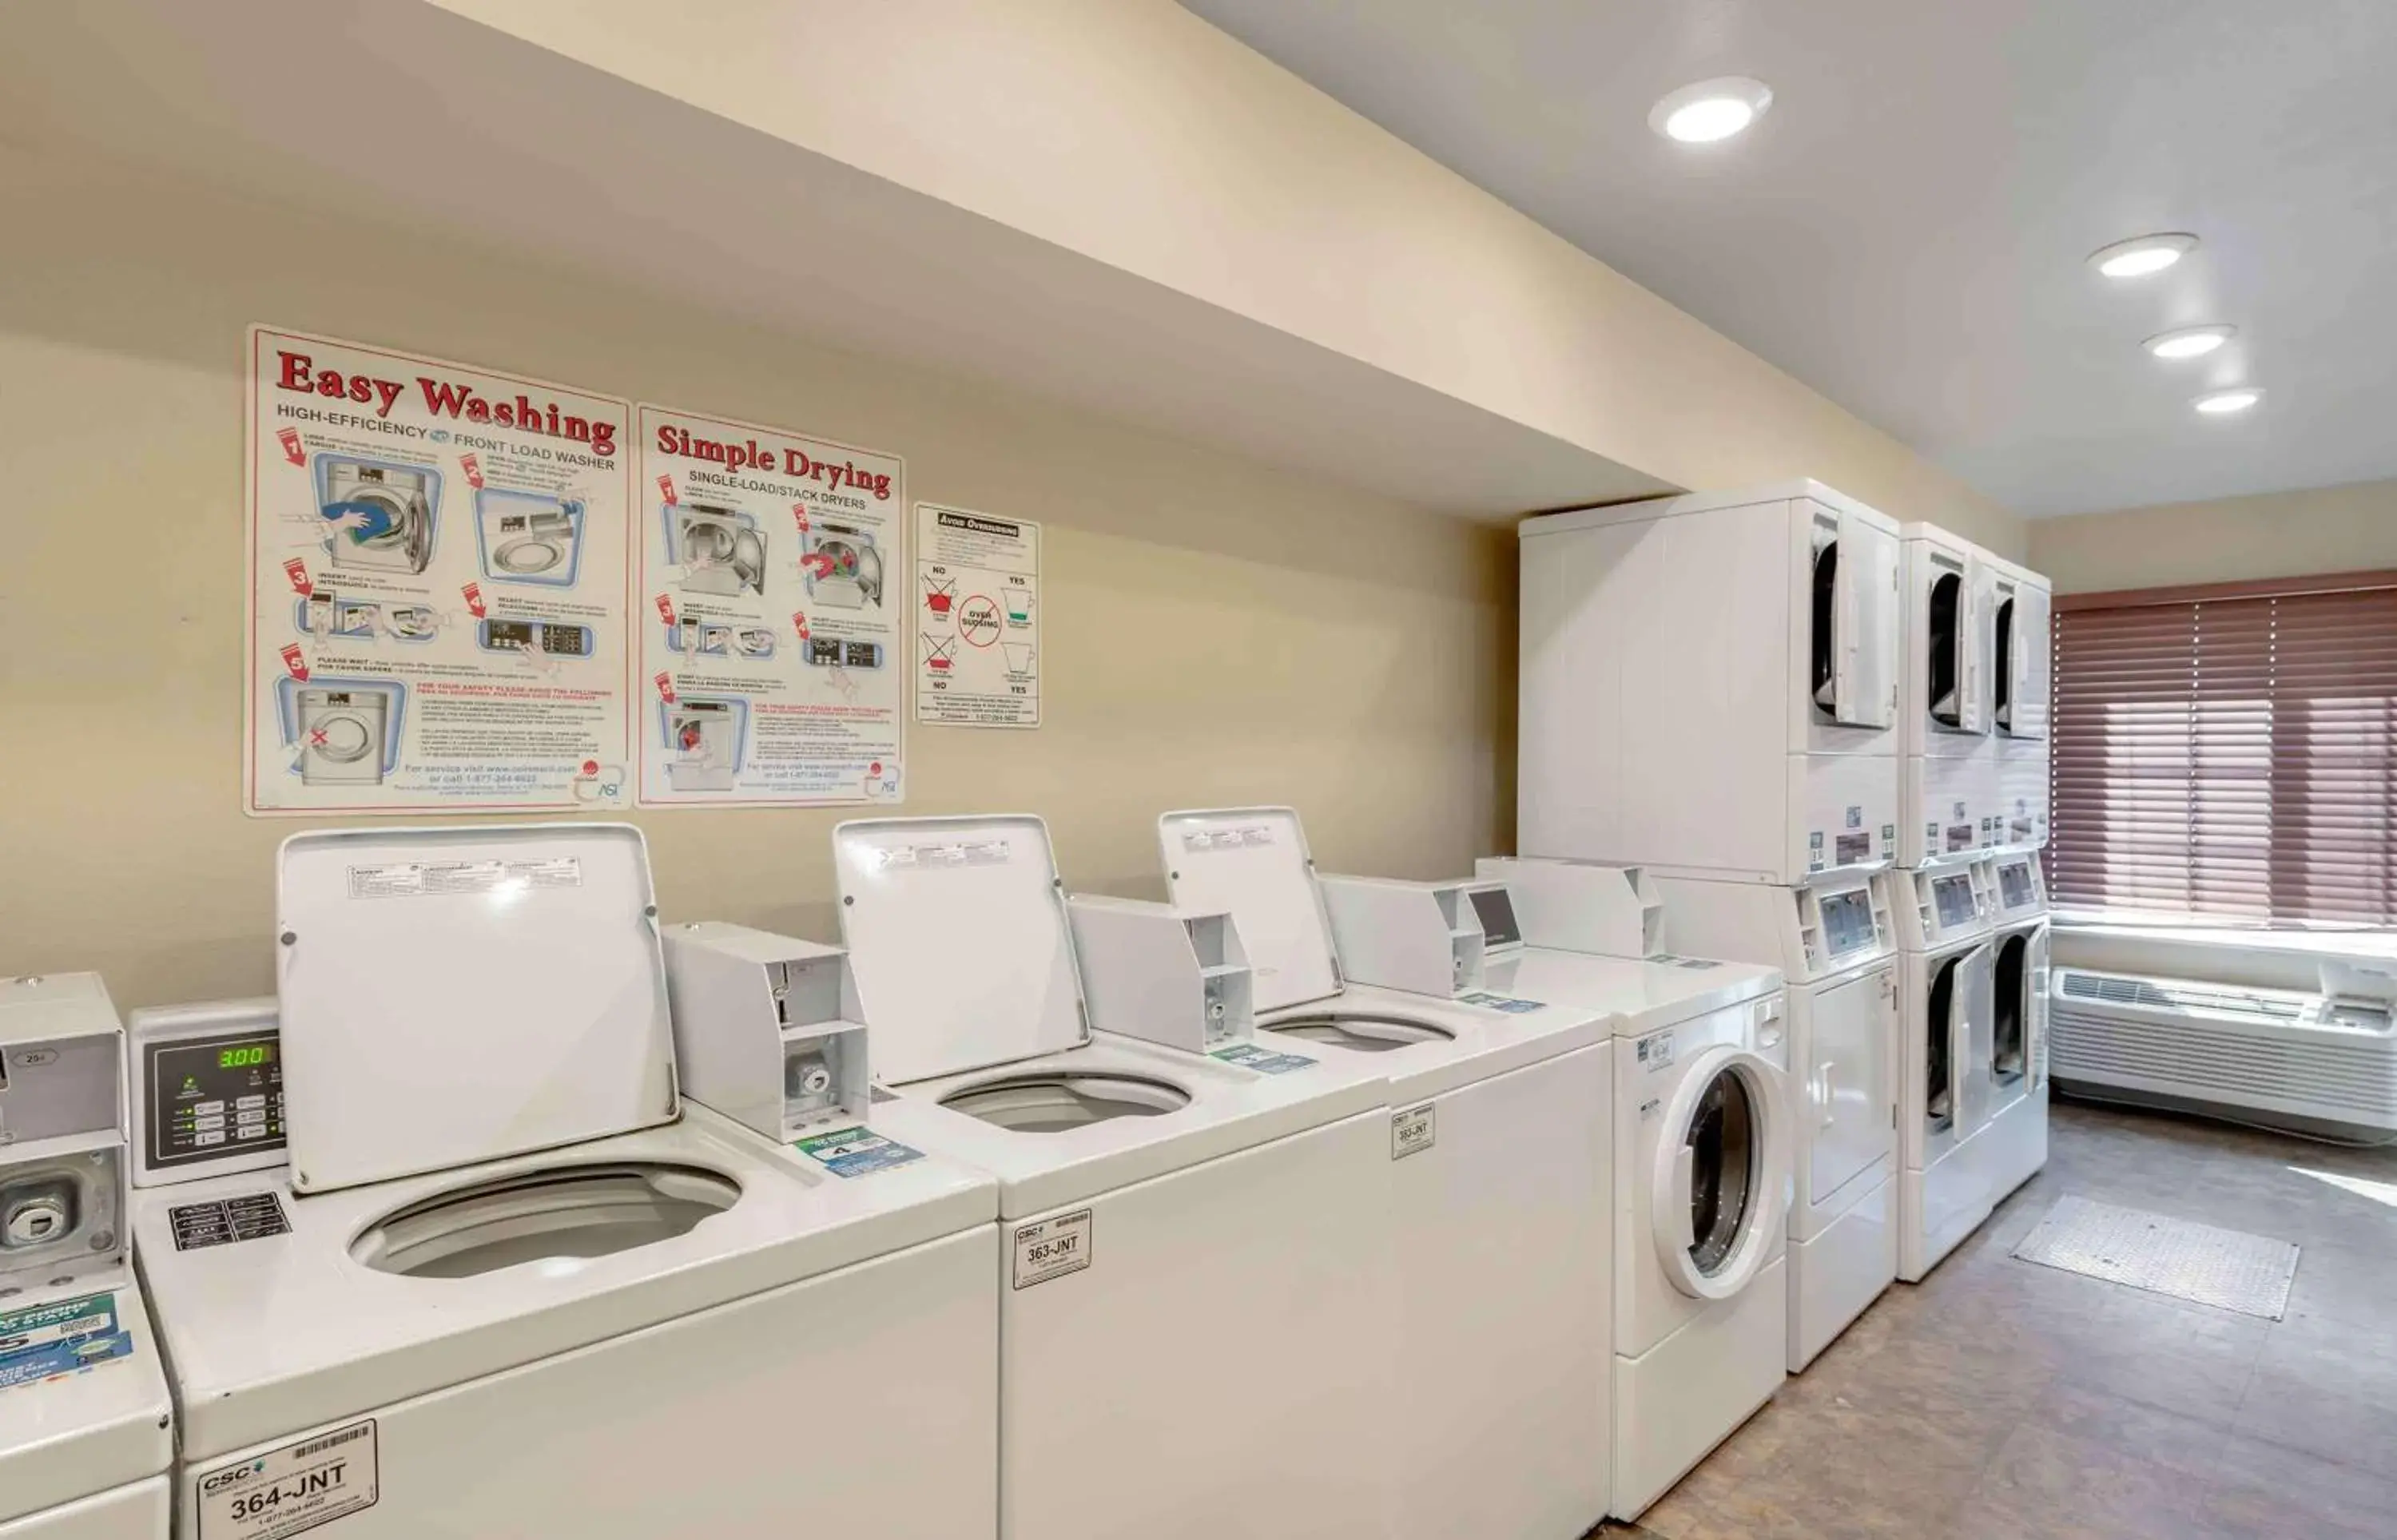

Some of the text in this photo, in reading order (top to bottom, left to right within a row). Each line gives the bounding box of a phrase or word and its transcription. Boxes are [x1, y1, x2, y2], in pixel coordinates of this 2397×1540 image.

[276, 350, 617, 457] Easy Washing
[277, 403, 427, 440] HIGH-EFFICIENCY
[454, 433, 506, 455] FRONT
[510, 440, 552, 461] LOAD
[555, 447, 615, 471] WASHER
[657, 423, 891, 500] Simple Drying
[690, 470, 866, 510] SINGLE-LOAD/STACK DRYERS
[932, 566, 946, 574] NO
[1009, 576, 1025, 585] YES
[969, 610, 992, 619] OVER
[933, 681, 946, 690] NO
[1028, 1236, 1078, 1262] 363-JNT
[204, 1467, 252, 1490] CSC
[231, 1462, 347, 1520] 364-JNT
